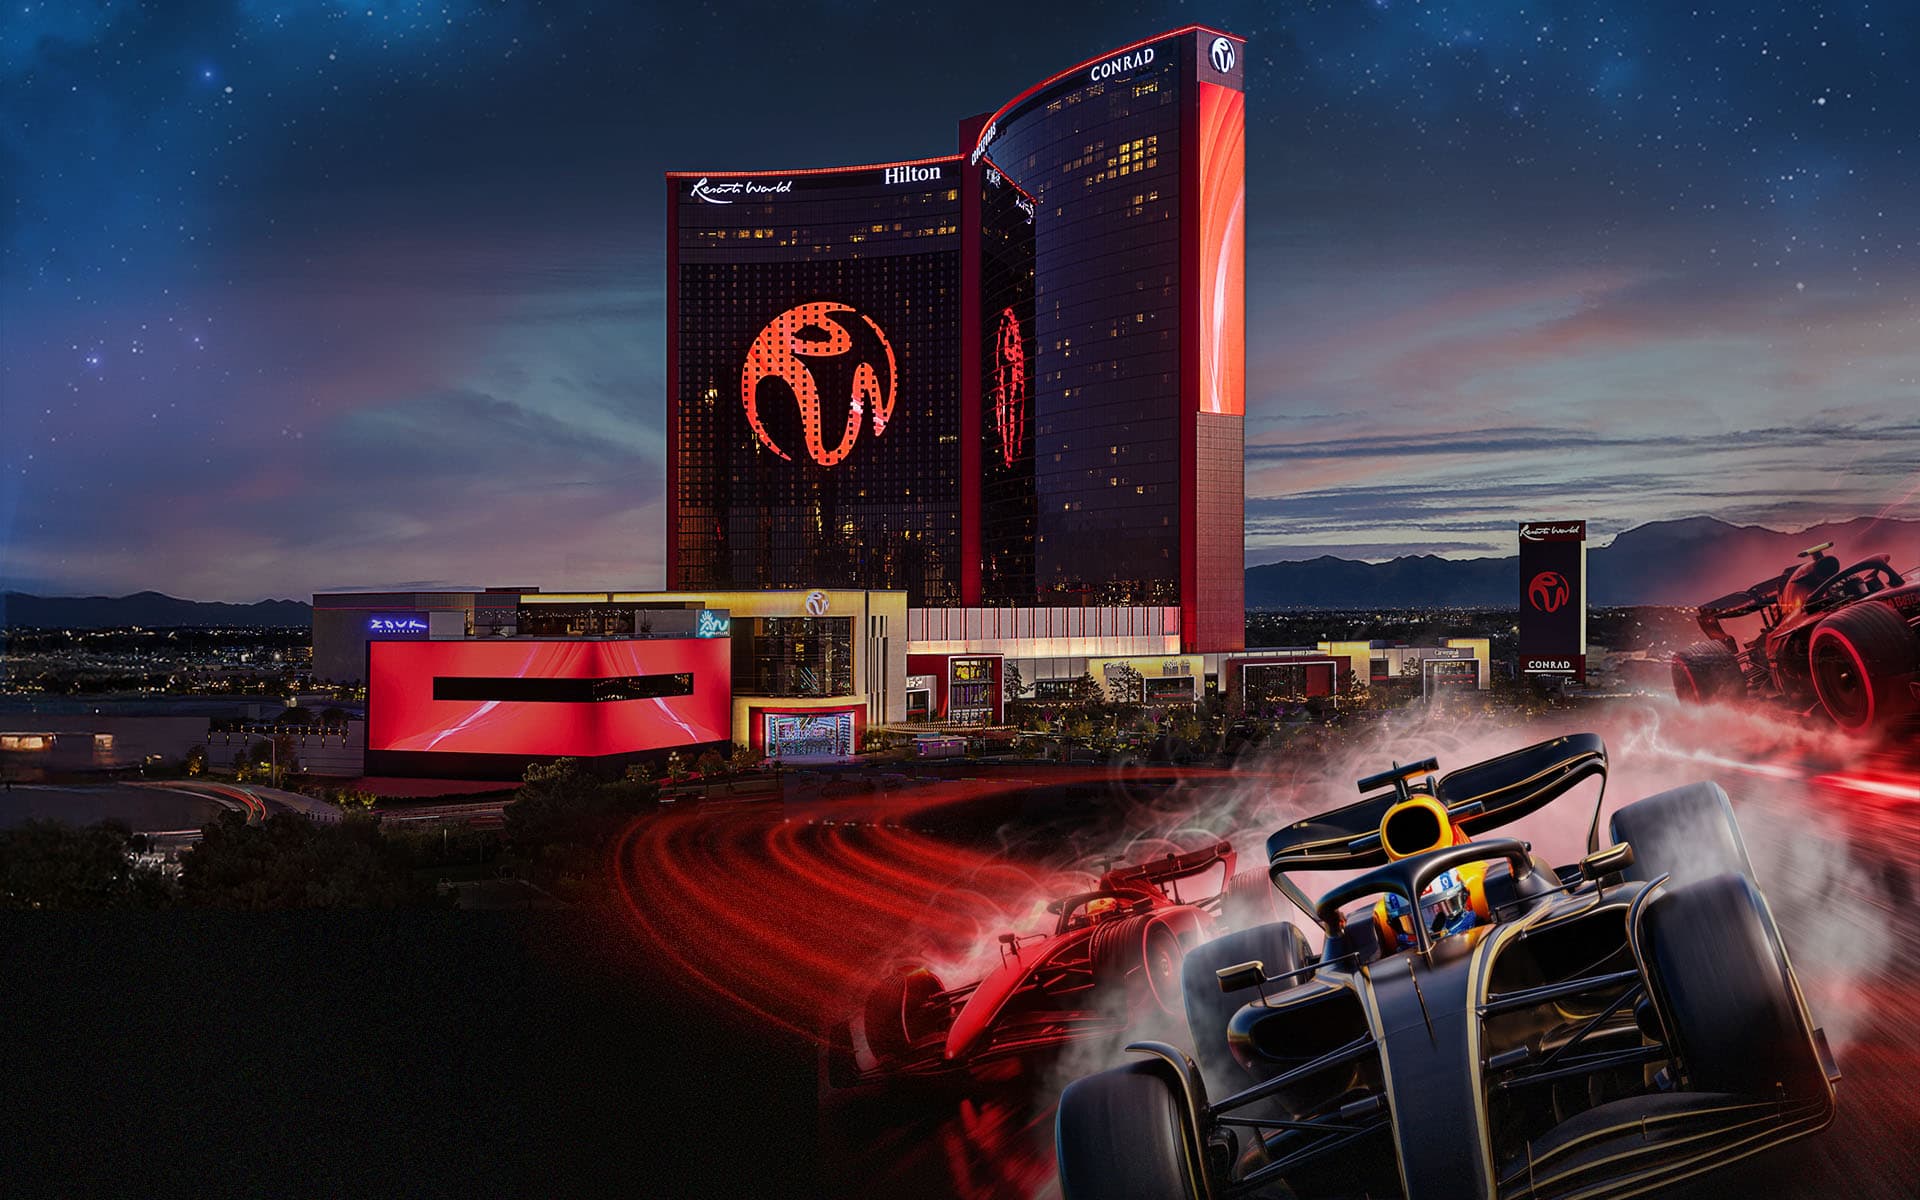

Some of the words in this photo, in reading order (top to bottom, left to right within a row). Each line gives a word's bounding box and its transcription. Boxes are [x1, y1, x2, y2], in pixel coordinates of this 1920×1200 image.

[1091, 48, 1155, 81] CONRAD
[884, 165, 941, 185] Hilton
[690, 177, 744, 204] Resorts
[745, 180, 792, 194] World
[1551, 525, 1580, 534] World
[371, 619, 428, 630] ZOUK
[1528, 660, 1570, 669] CONRAD
